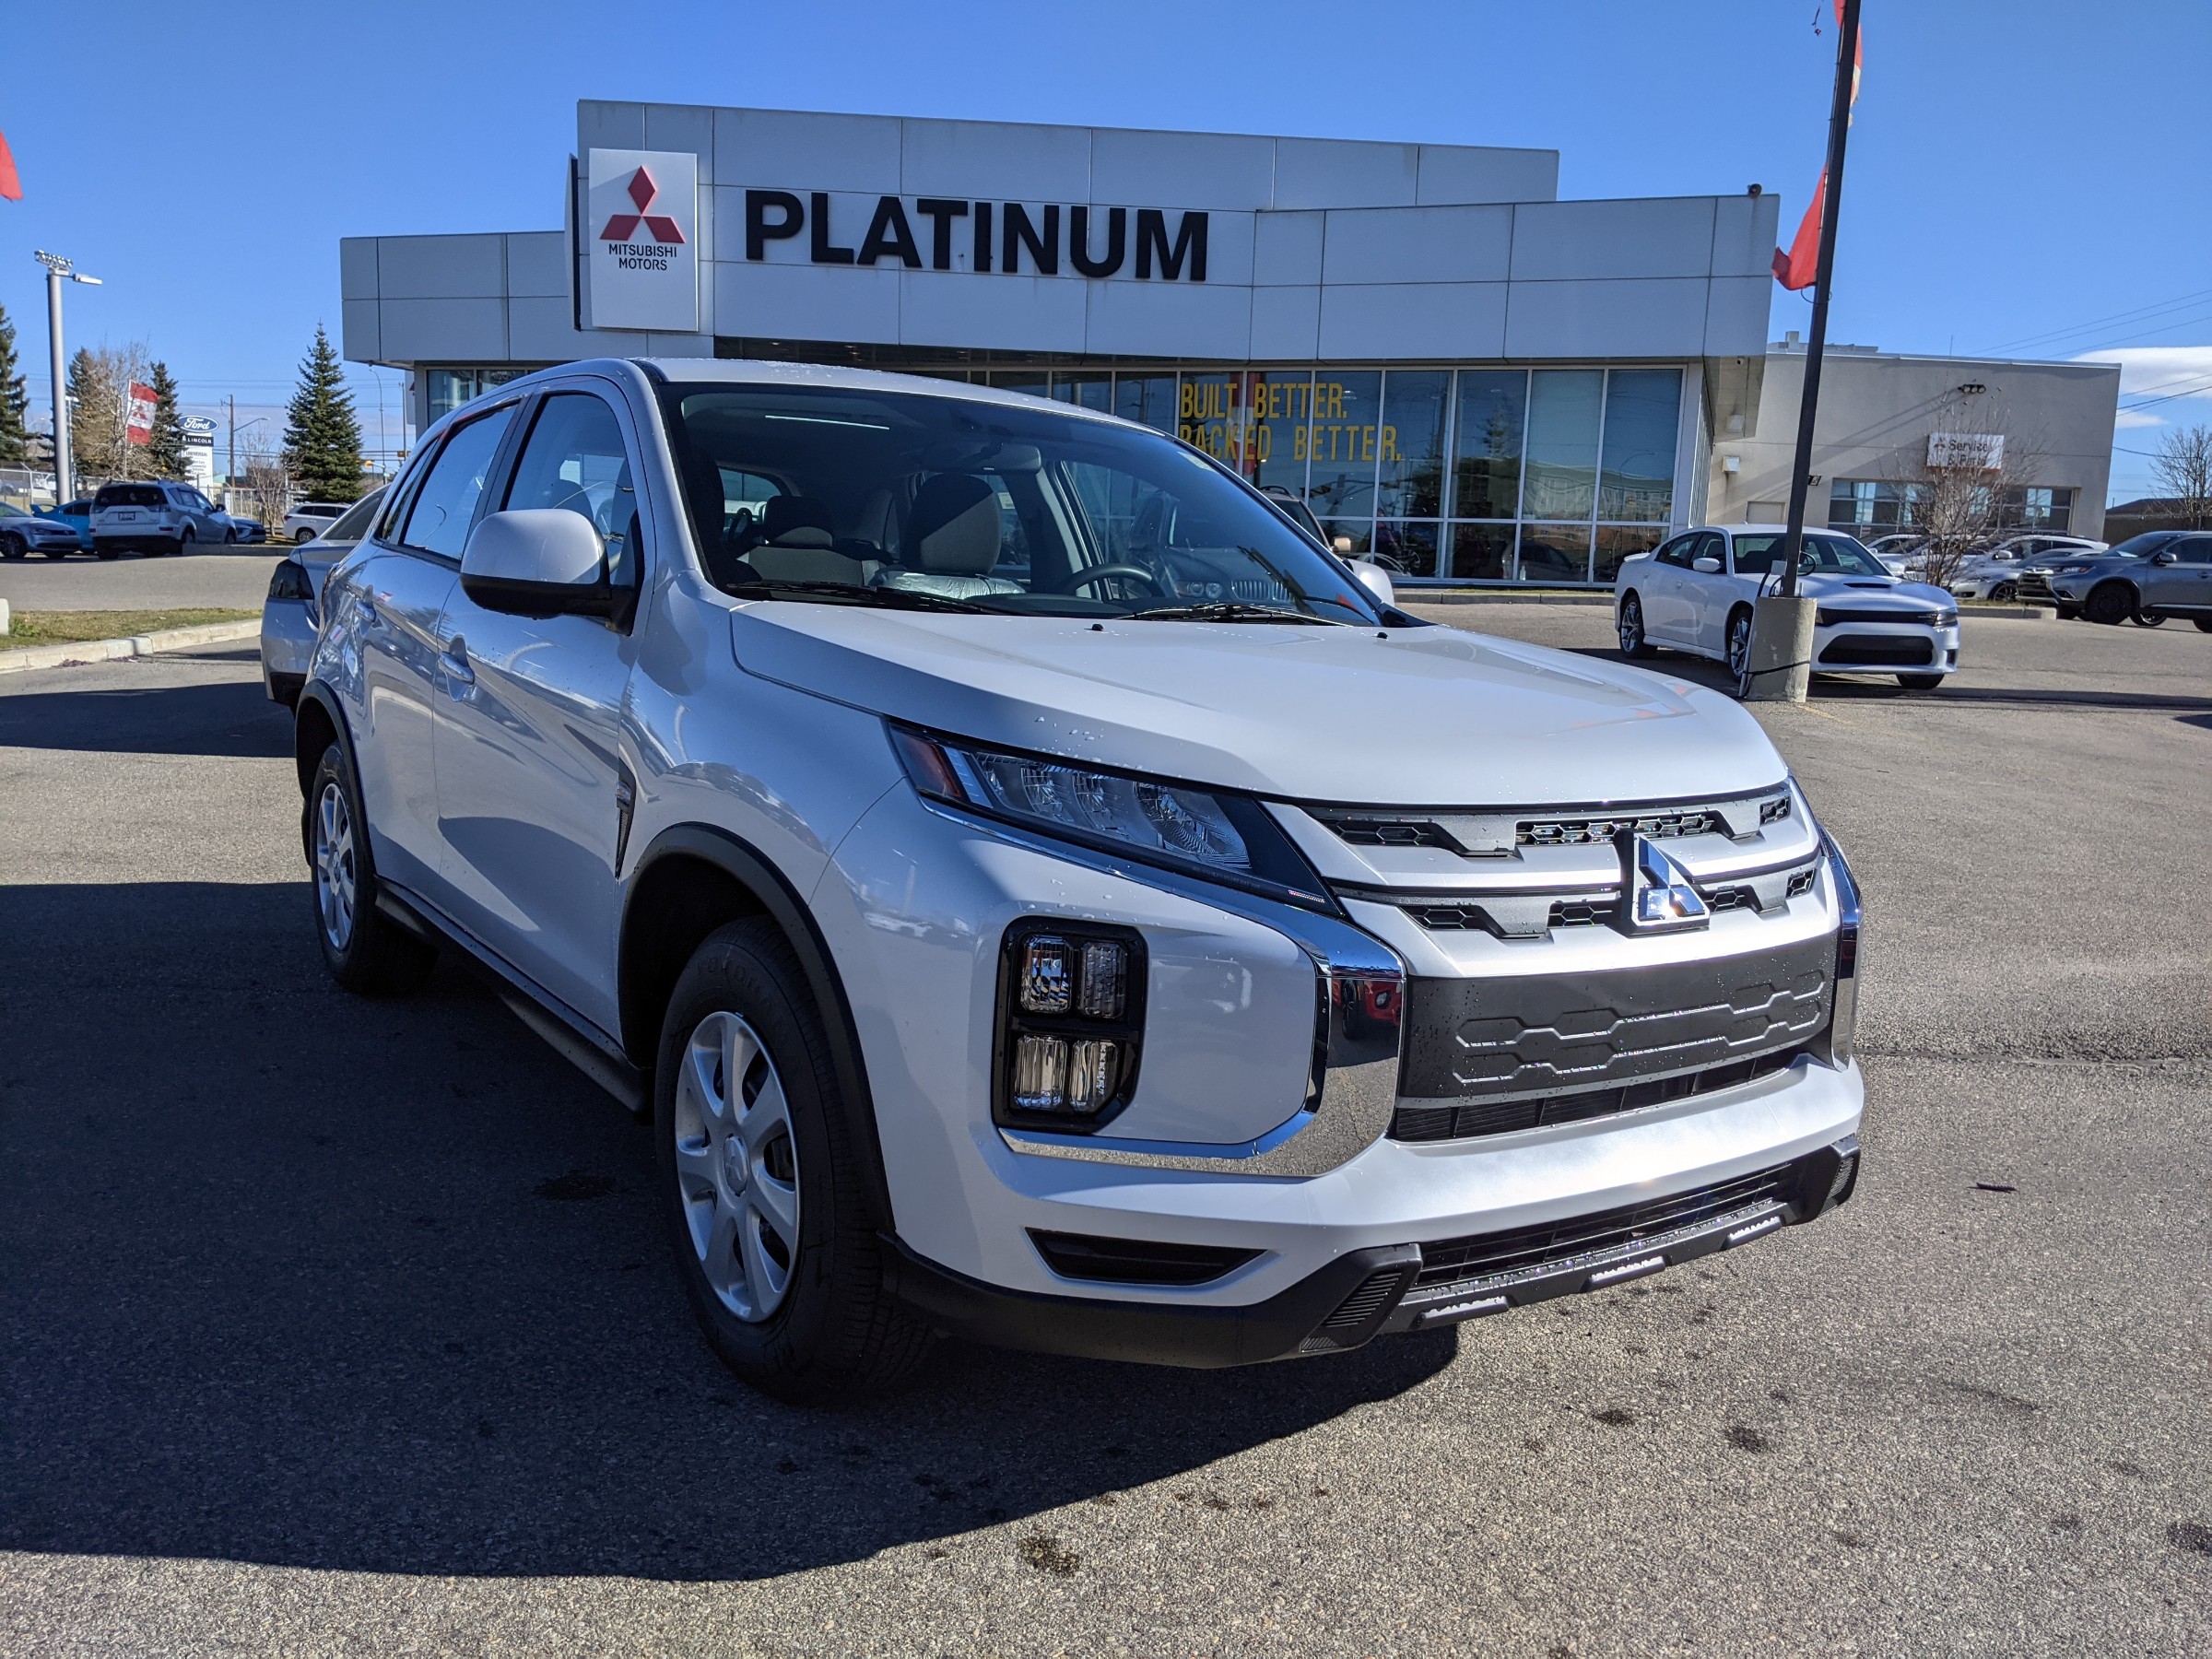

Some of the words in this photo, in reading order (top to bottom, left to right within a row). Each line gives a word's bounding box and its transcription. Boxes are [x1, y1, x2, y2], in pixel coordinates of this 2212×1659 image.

[745, 189, 1209, 281] PLATINUM
[608, 243, 677, 258] MITSUBISHI
[618, 258, 668, 271] MOTORS
[1180, 382, 1238, 418] BUILT
[1253, 382, 1348, 418] BETTER.
[184, 418, 211, 429] Ford
[1293, 424, 1403, 461] BETTER.
[1948, 439, 1989, 453] Service
